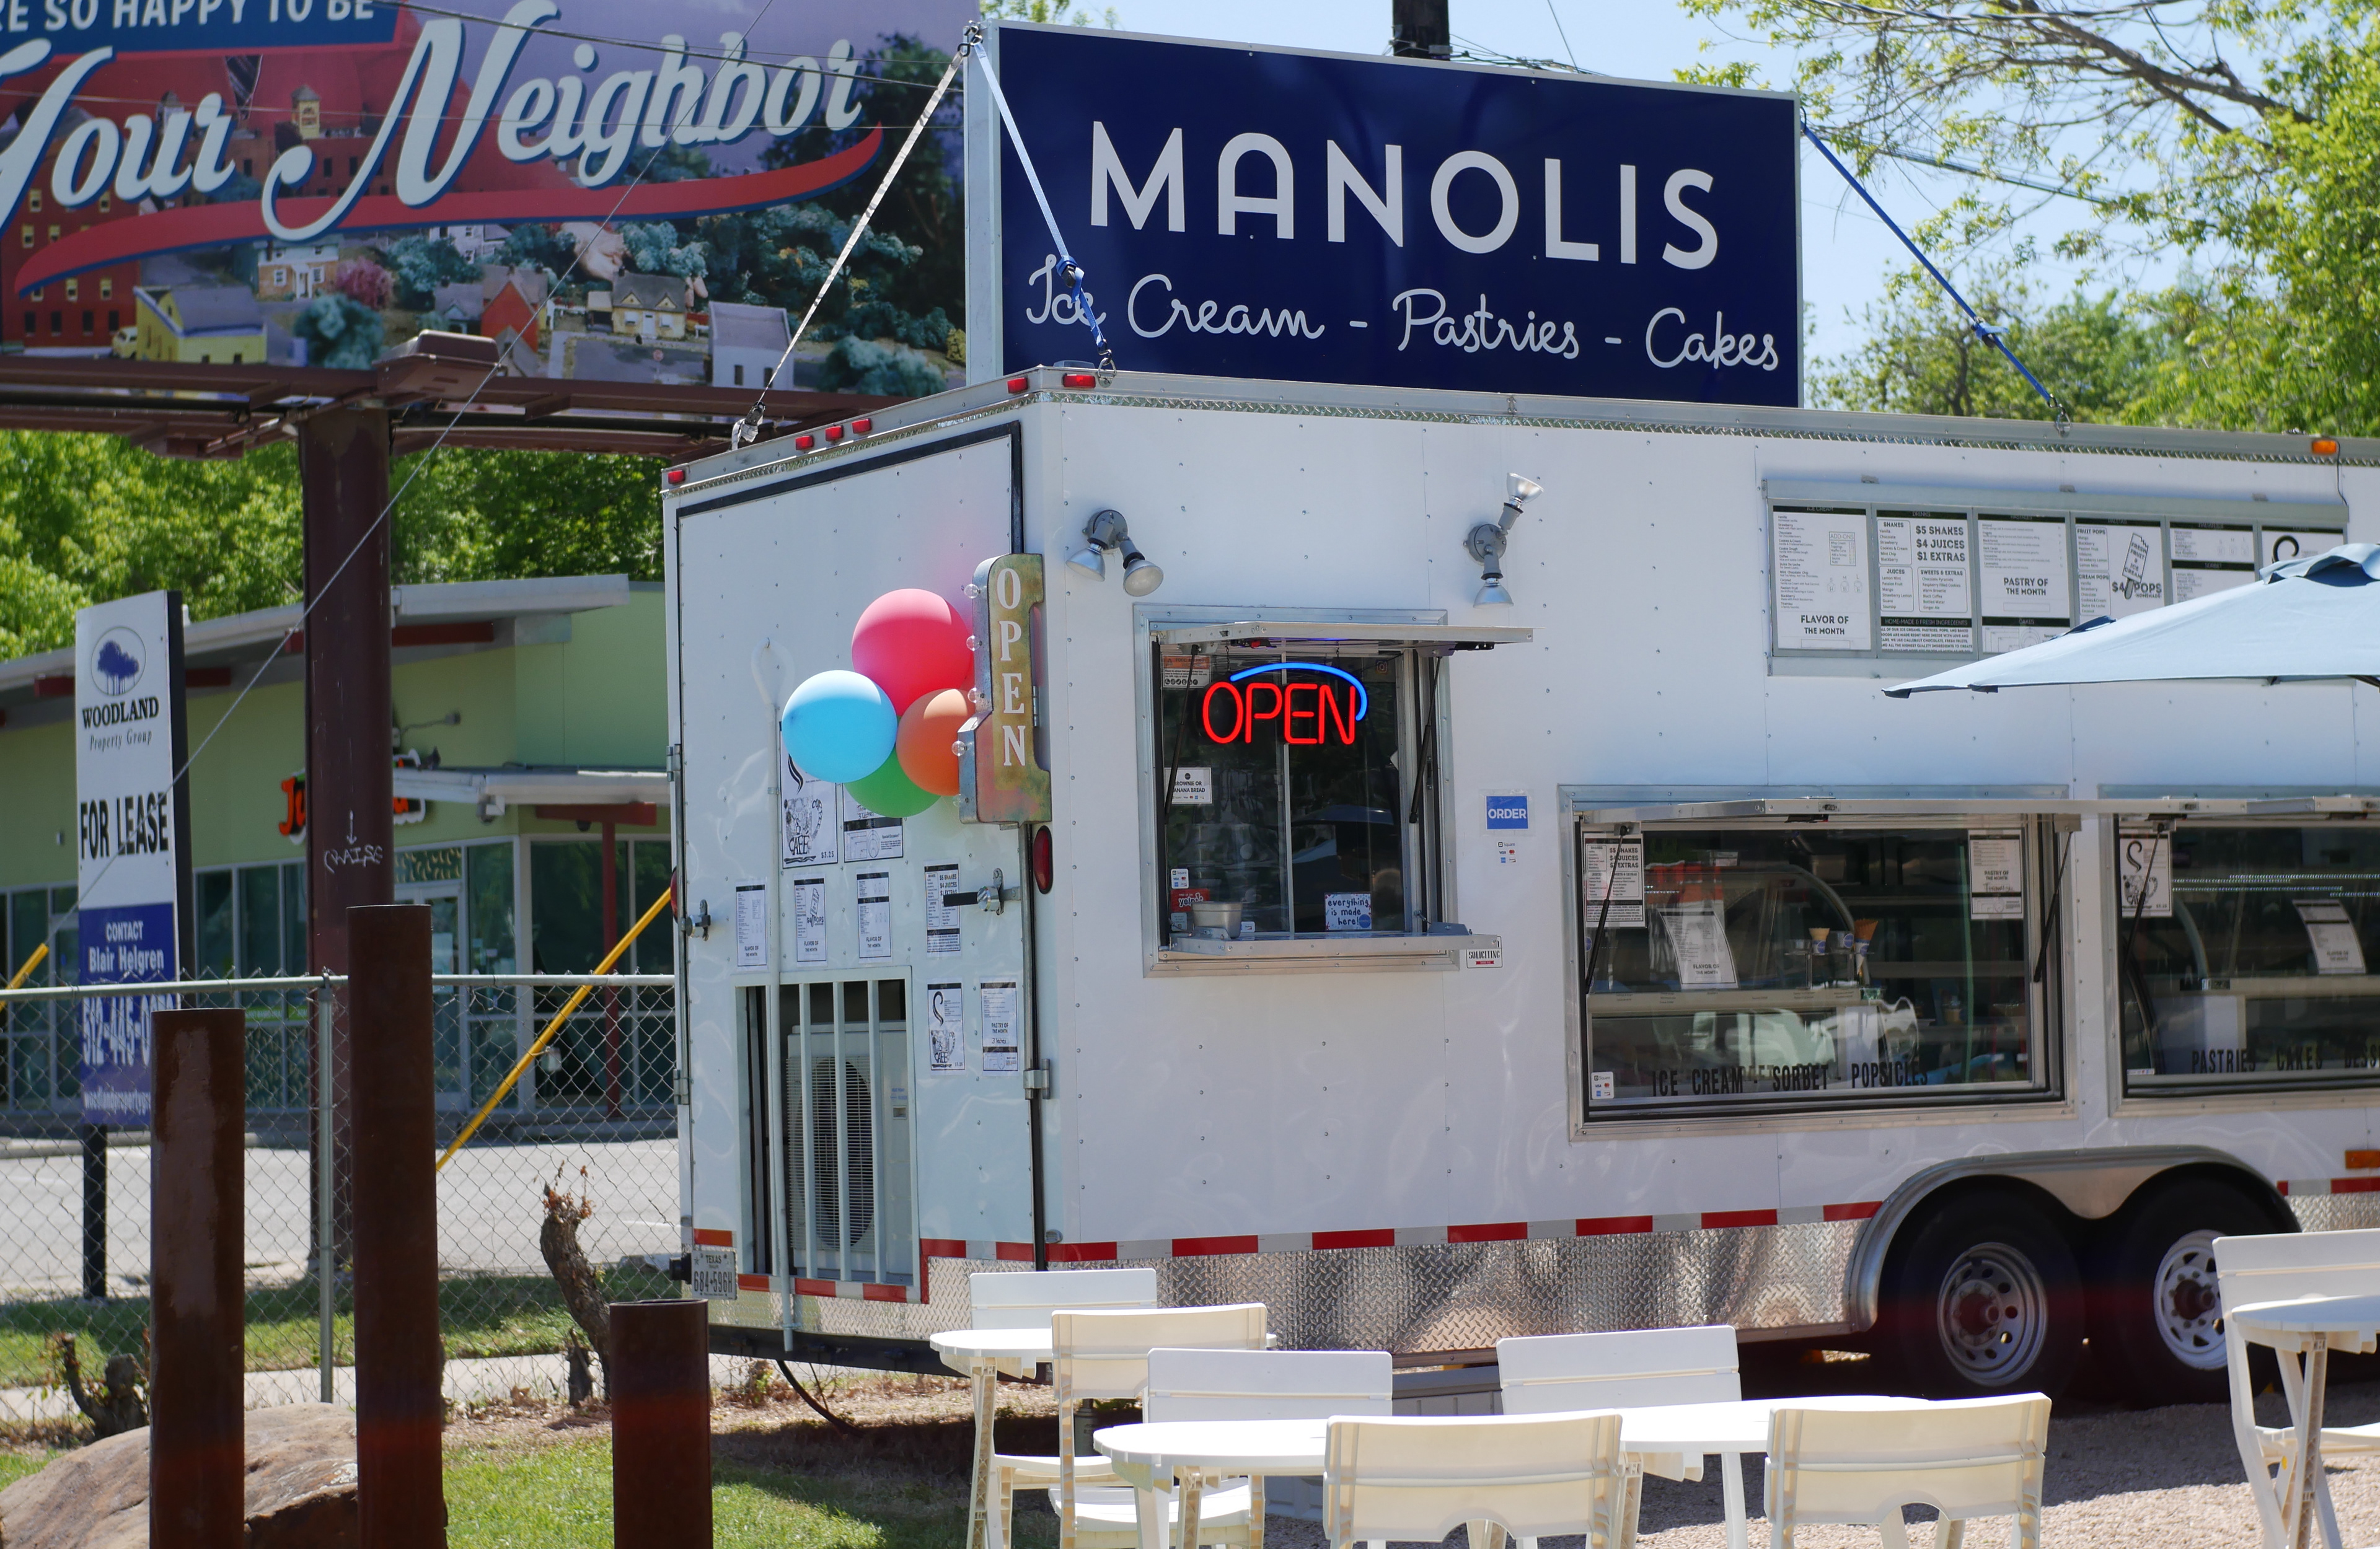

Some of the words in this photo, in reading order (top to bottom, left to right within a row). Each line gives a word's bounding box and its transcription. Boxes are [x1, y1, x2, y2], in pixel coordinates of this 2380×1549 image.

[45, 0, 98, 31] SO
[113, 0, 247, 29] HAPPY
[262, 0, 863, 241] Neighbor
[1091, 121, 1717, 270] MANOLIS
[1128, 274, 1325, 340] Cream
[1392, 288, 1579, 359] Pastries
[1646, 307, 1779, 371] Cakes
[1915, 525, 1926, 534] $5
[1929, 527, 1963, 535] SHAKES
[1916, 539, 1928, 548] $4
[1931, 539, 1965, 549] JUICES
[1917, 551, 1927, 561] $1
[1930, 551, 1965, 561] EXTRAS
[2003, 577, 2034, 586] PASTRY
[2037, 578, 2048, 586] OF
[2134, 582, 2162, 594] POPS
[1801, 615, 1835, 624] FLAVOR
[1837, 616, 1849, 624] OF
[997, 568, 1026, 767] OPEN
[82, 696, 160, 729] WOODLAND
[1202, 682, 1356, 745] OPEN
[90, 733, 123, 753] Property
[126, 729, 152, 745] Group
[1488, 808, 1527, 819] ORDER
[80, 799, 110, 860] FOR
[116, 791, 169, 856] LEASE
[1328, 897, 1368, 908] everything
[1331, 908, 1337, 916] is
[1341, 907, 1361, 916] made
[105, 921, 143, 943] CONTACT
[1338, 917, 1359, 925] here!
[88, 946, 115, 973] Blair
[118, 944, 165, 976] Helgren
[1469, 950, 1500, 959] SOLICITING
[2192, 1048, 2256, 1074] PASTRIES
[2276, 1045, 2322, 1071] CAKES
[1652, 1068, 1678, 1097] ICE
[1691, 1066, 1743, 1095] CREAM
[1773, 1064, 1828, 1092] SORBET
[1851, 1061, 1928, 1089] POPSICLES
[705, 1255, 721, 1264] TEXAS
